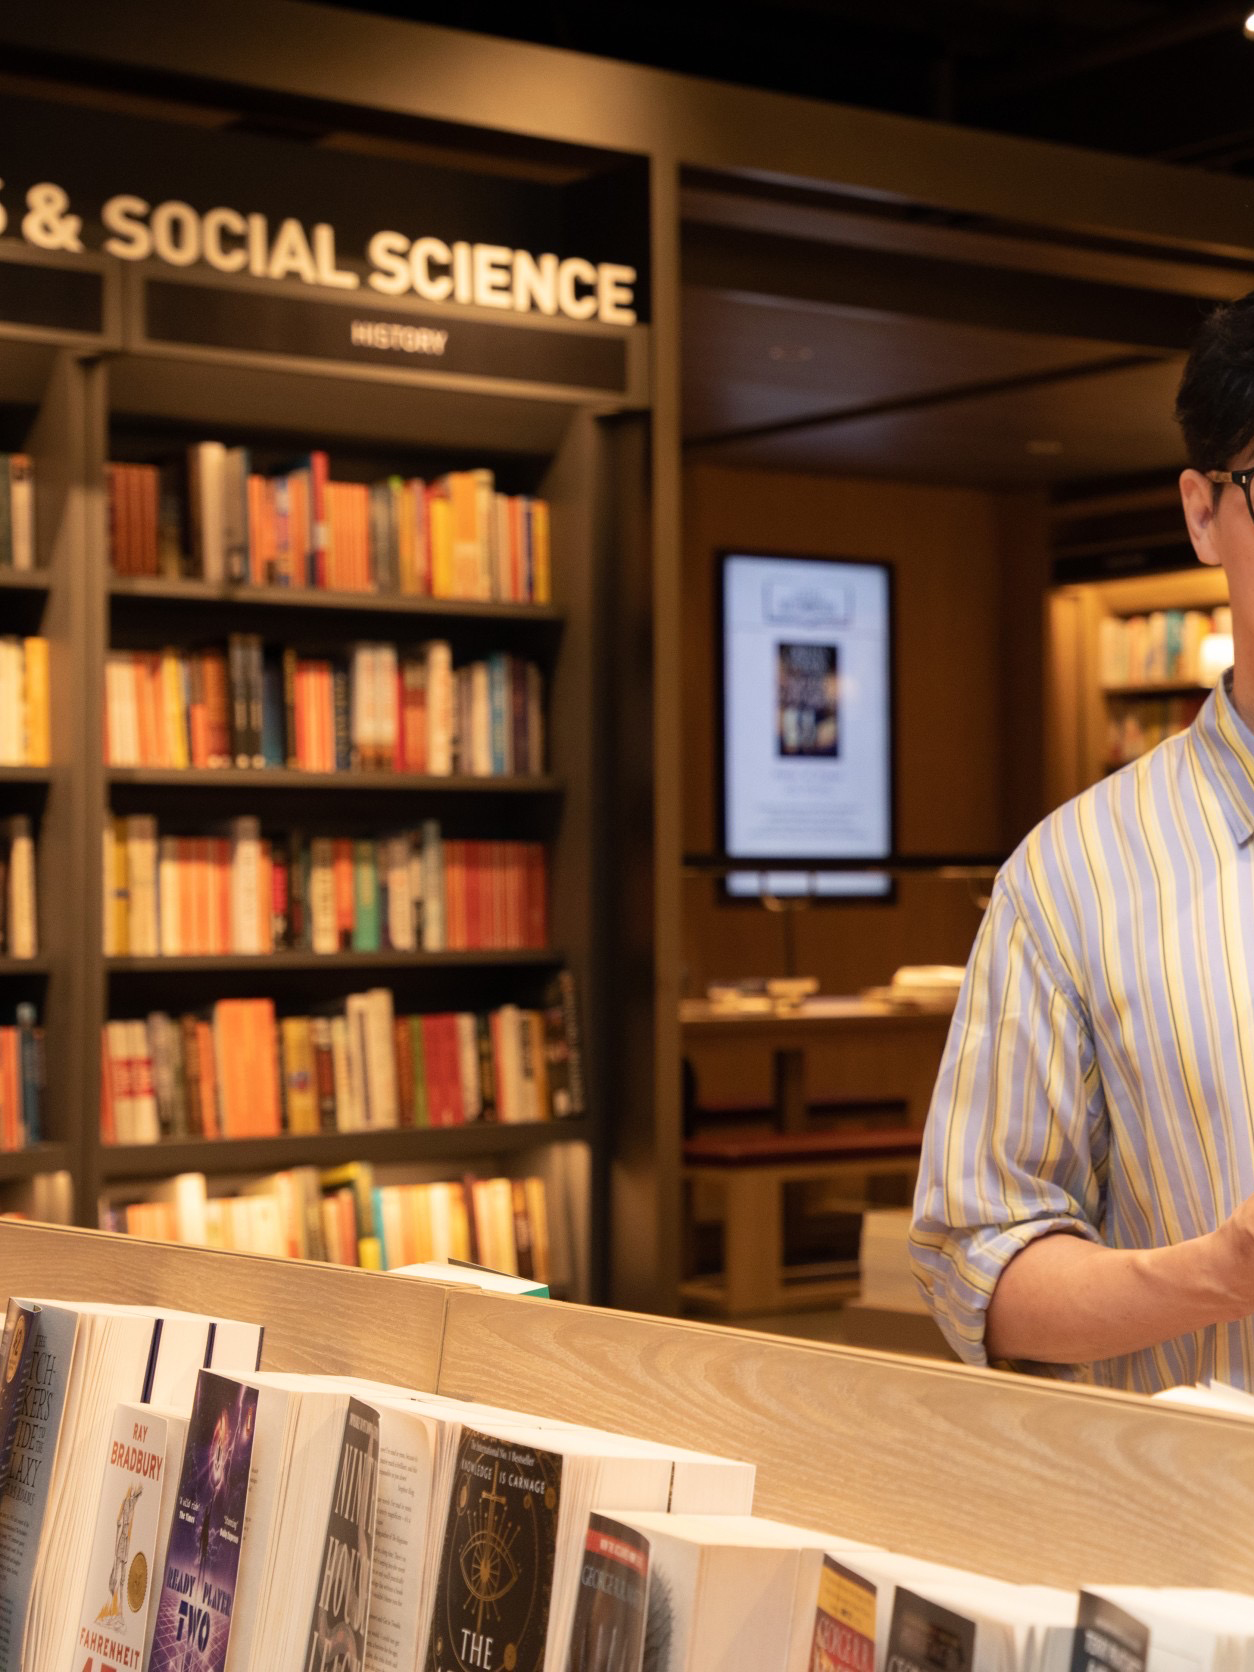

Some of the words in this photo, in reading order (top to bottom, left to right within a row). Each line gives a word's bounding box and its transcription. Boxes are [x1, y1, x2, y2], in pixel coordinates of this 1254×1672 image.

[22, 182, 84, 253] &
[102, 194, 360, 291] SOCIAL
[367, 230, 638, 326] SCIENCE
[351, 319, 449, 357] HISTORY
[133, 1422, 149, 1443] RAY
[110, 1440, 164, 1482] BRADBURY
[461, 1457, 493, 1481] KNOWLEDGE
[498, 1470, 507, 1486] IS
[508, 1474, 546, 1495] CARNAGE
[166, 1566, 197, 1598] READY
[202, 1582, 232, 1618] PLAYER
[176, 1599, 211, 1654] TWO
[79, 1627, 141, 1671] FAHRENHEIT
[461, 1627, 494, 1672] THE
